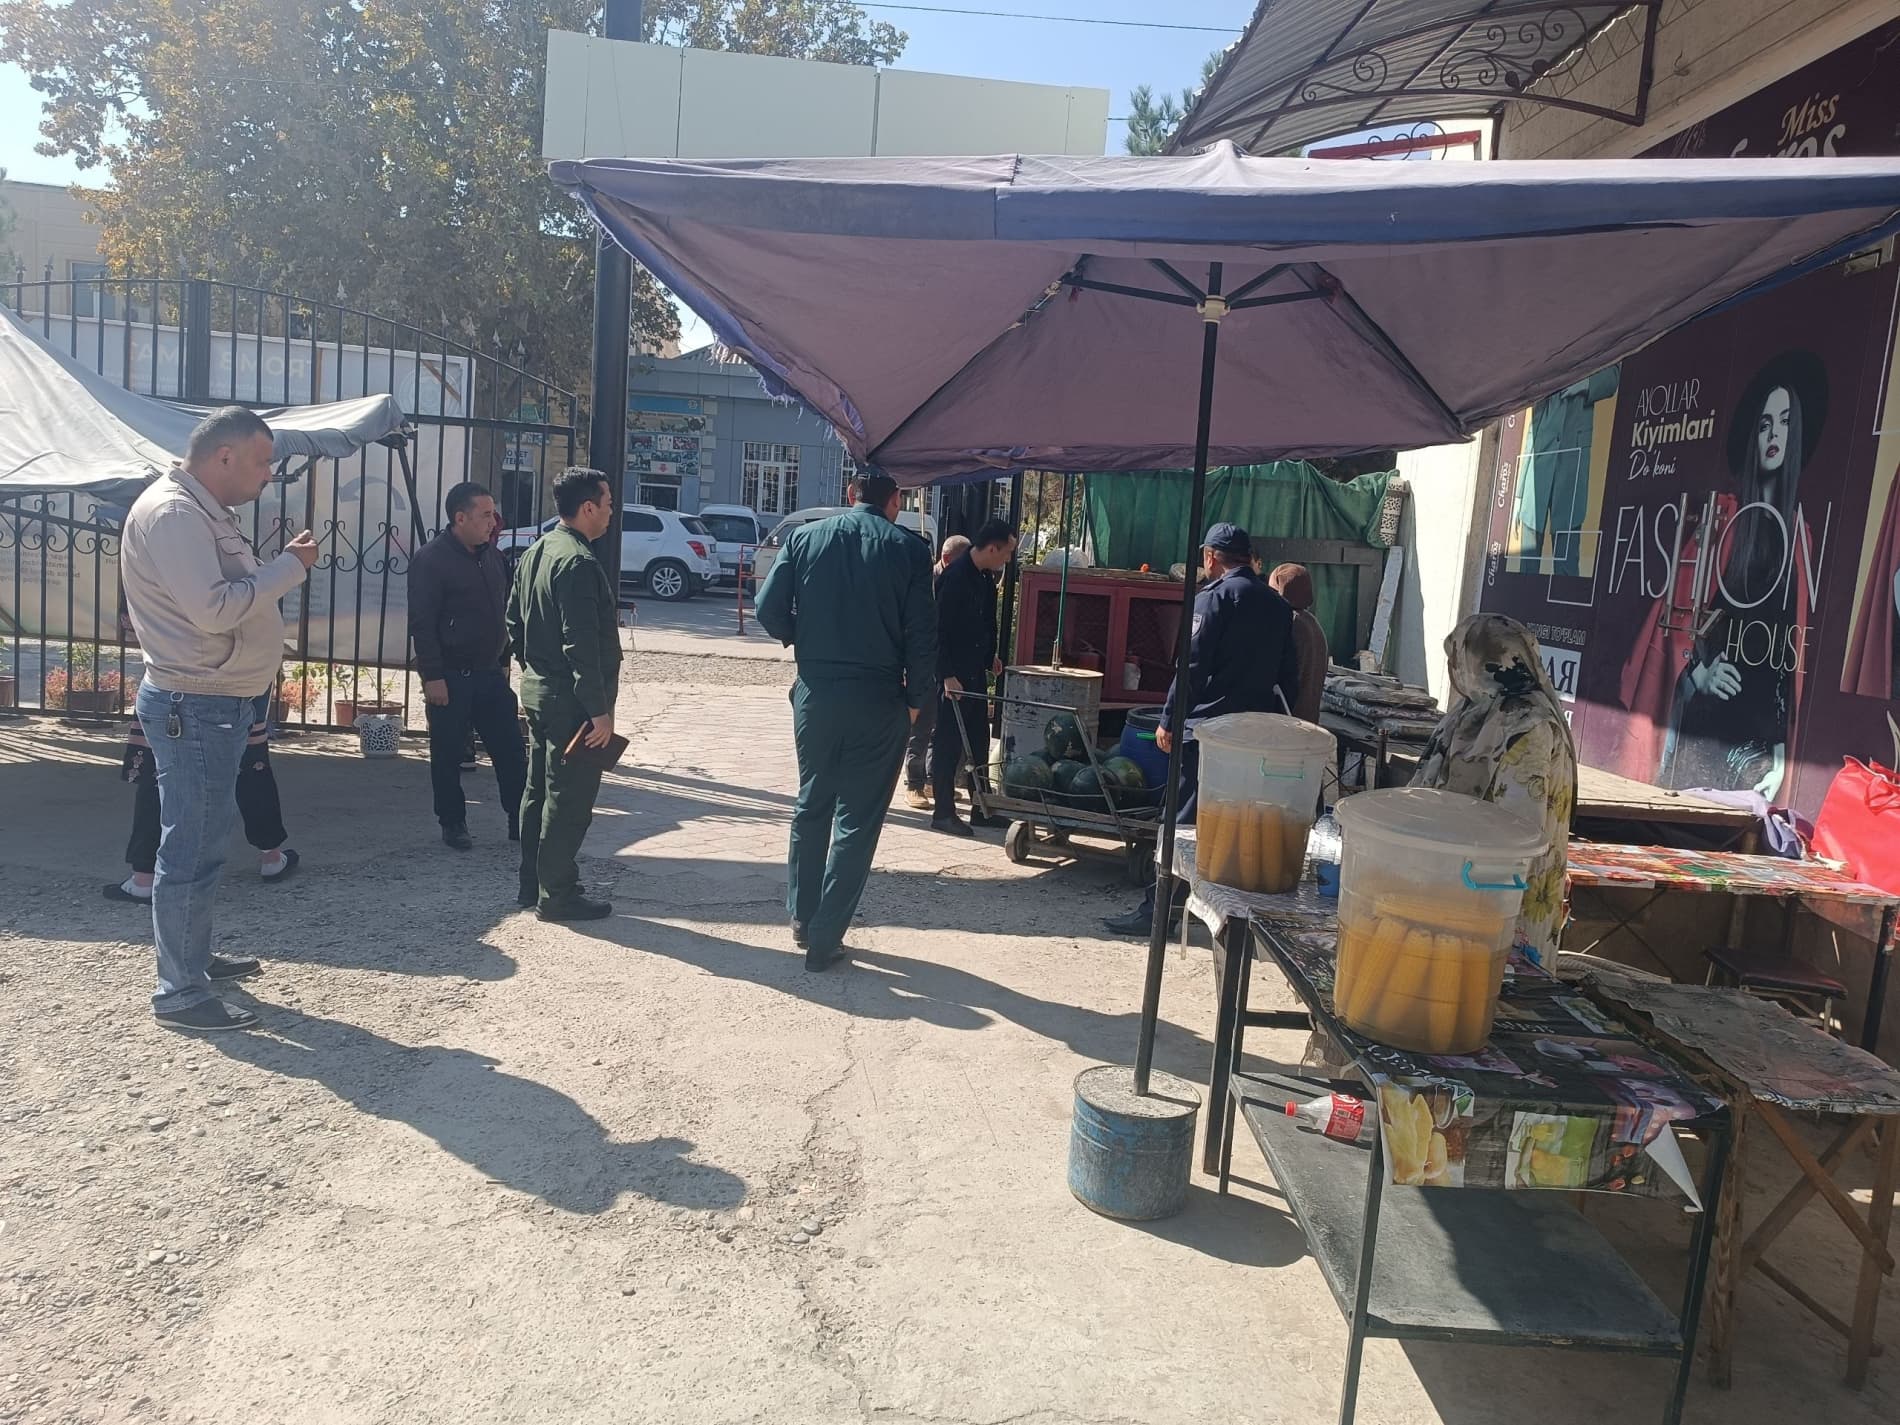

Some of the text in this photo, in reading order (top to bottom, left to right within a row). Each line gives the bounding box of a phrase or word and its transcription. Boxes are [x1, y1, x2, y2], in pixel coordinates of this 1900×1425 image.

[1777, 92, 1839, 146] Miss
[1635, 378, 1700, 418] AYOLLAR
[1631, 409, 1715, 452] Kiyimlari
[1609, 500, 1832, 614] FASHION
[1725, 618, 1814, 673] HOUSE
